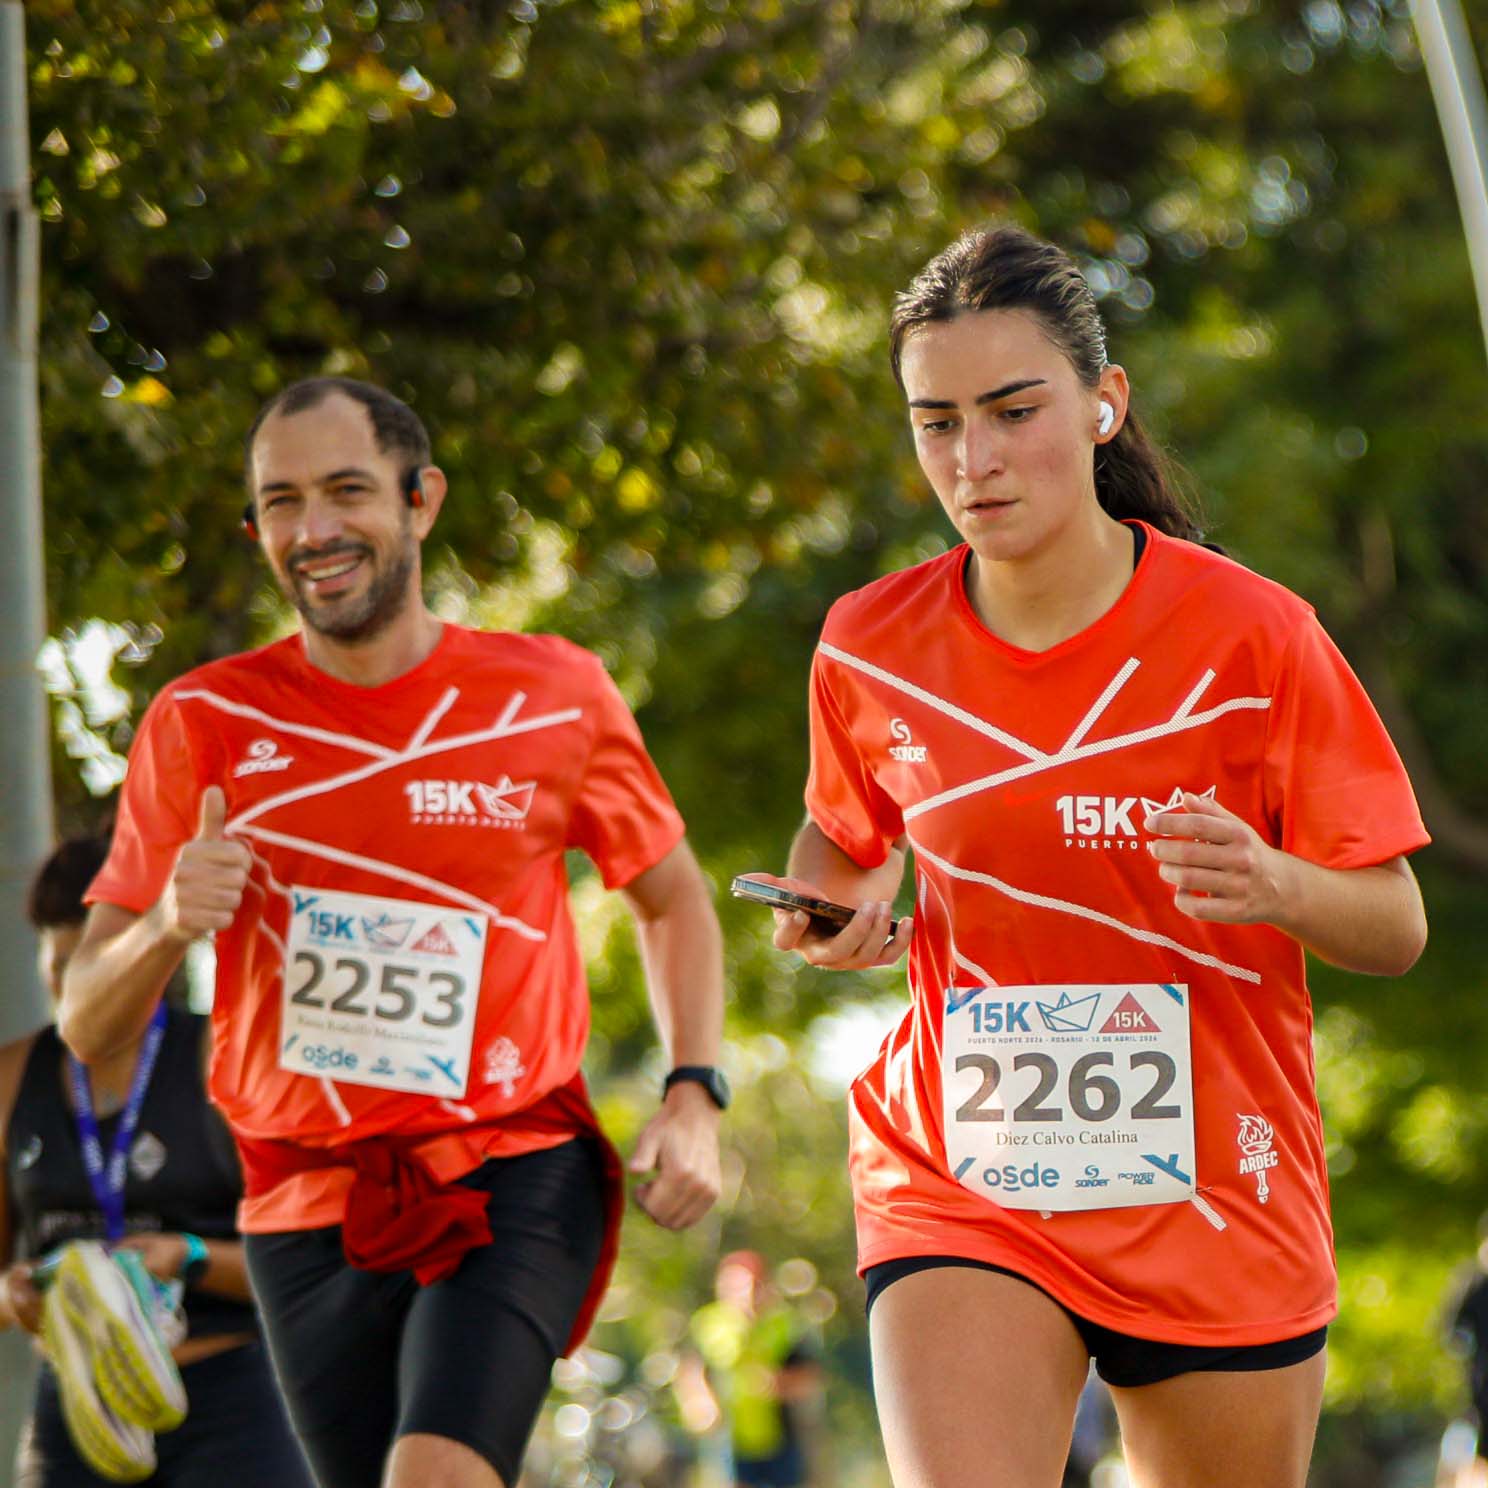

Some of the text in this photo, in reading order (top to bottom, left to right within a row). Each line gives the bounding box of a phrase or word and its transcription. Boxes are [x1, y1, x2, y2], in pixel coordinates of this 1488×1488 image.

[404, 780, 477, 815] 15K
[1056, 795, 1138, 836] 15K
[1065, 838, 1138, 849] PUERTO
[308, 911, 355, 940] 15K
[291, 951, 467, 1029] 2253
[968, 1001, 1031, 1033] 15K
[1111, 1011, 1147, 1029] 15K
[302, 1044, 358, 1070] osde
[955, 1050, 1182, 1122] 2262
[995, 1130, 1138, 1146] Diez Calvo Catalina
[982, 1161, 1060, 1192] osde
[1239, 1151, 1279, 1174] ARDEC
